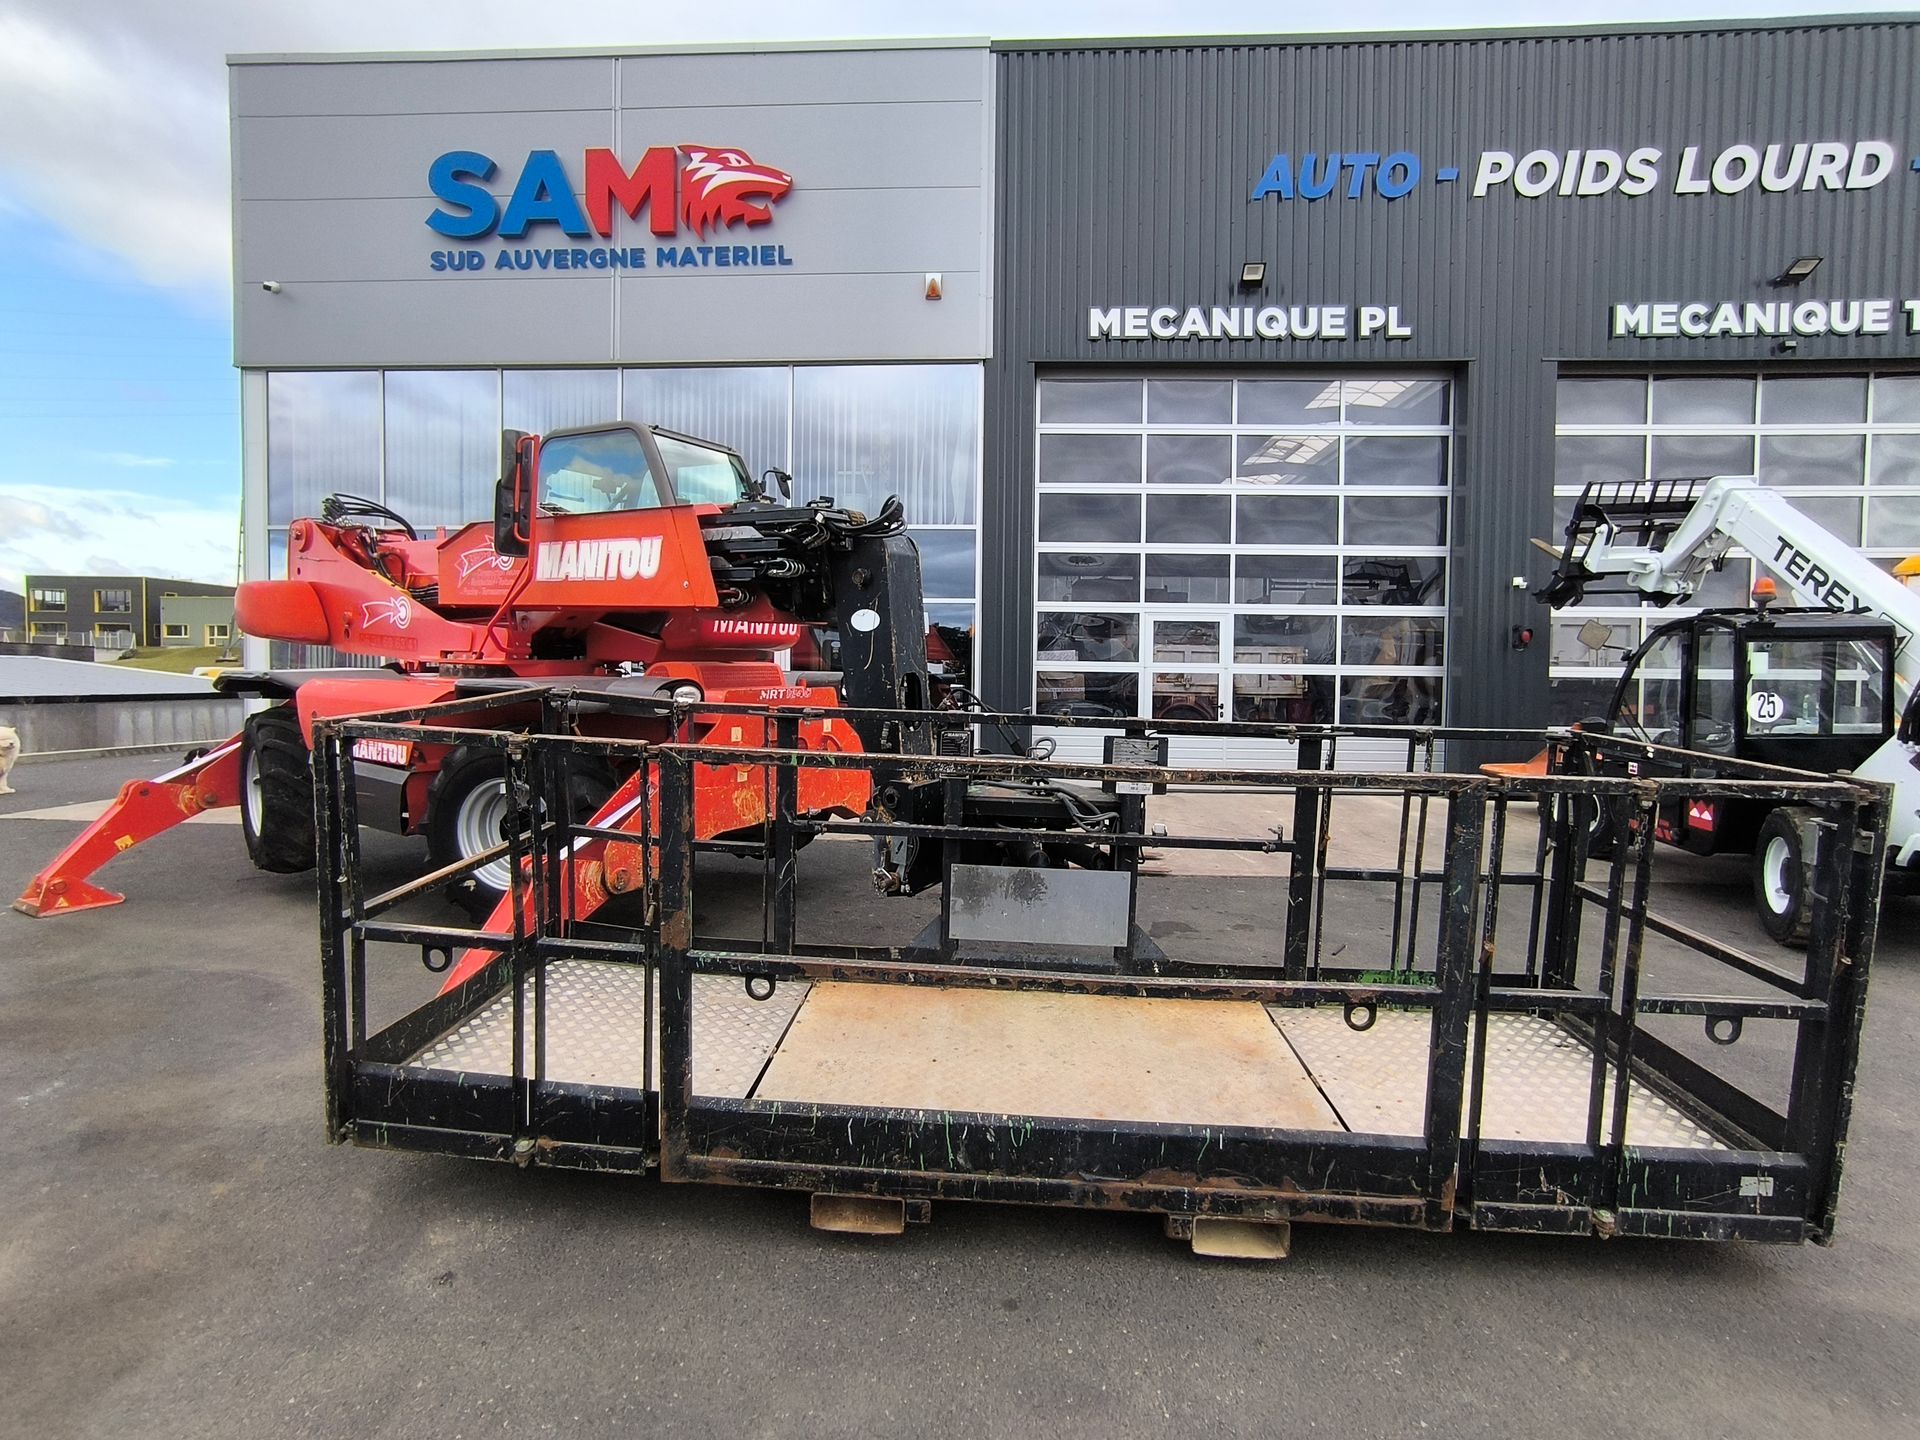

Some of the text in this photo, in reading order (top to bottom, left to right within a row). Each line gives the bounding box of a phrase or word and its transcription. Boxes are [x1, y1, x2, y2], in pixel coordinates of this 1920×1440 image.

[1251, 152, 1421, 201] AUTO
[1472, 147, 1663, 198] POIDS
[1674, 141, 1895, 195] LOURD
[425, 146, 678, 239] SAM
[430, 244, 794, 272] SUD AUVERGNE MATERIEL
[1088, 305, 1413, 340] MECANIQUE PL
[1613, 300, 1892, 337] MECANIQUE
[535, 535, 663, 581] MANITOU
[1758, 693, 1776, 719] 25
